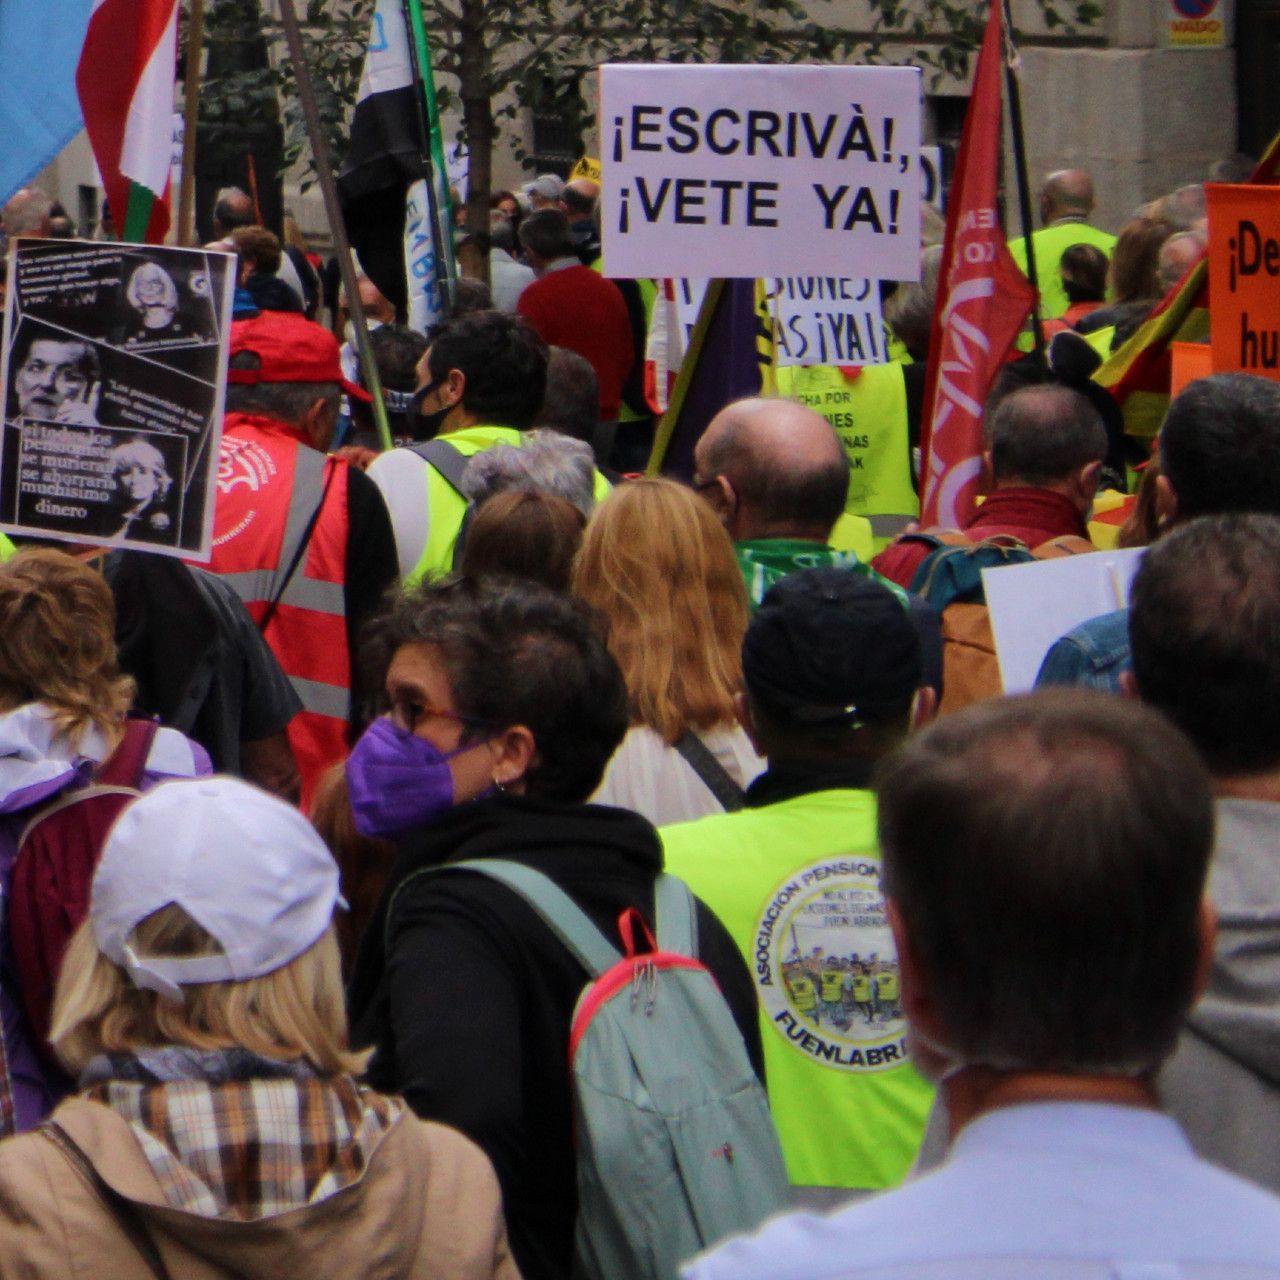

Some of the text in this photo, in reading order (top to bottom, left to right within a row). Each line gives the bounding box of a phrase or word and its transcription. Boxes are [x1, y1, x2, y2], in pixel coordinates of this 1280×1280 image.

[612, 102, 910, 174] ¡ESCRIVÀ!,
[617, 175, 901, 235] ¡VETE YA!
[814, 311, 881, 364] ¡YA!
[825, 391, 851, 404] POR
[800, 861, 881, 887] PENSION
[773, 1008, 907, 1067] FUENLABR
